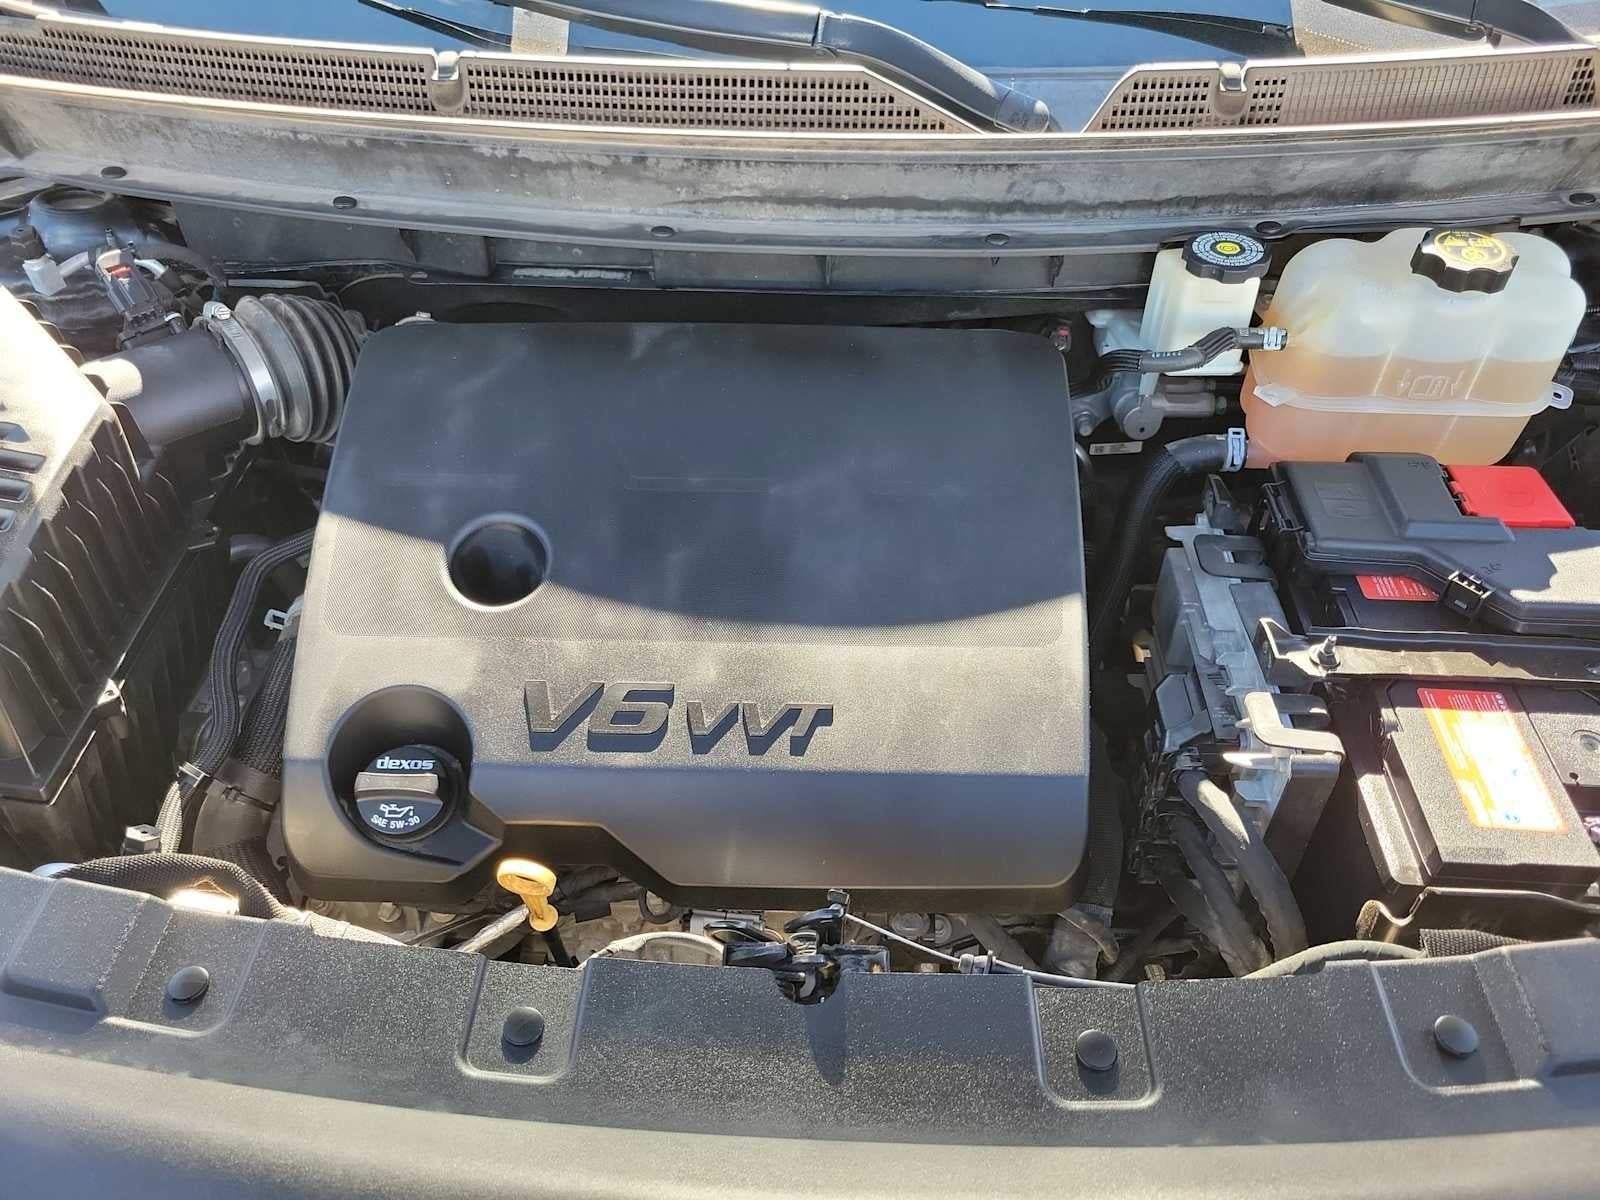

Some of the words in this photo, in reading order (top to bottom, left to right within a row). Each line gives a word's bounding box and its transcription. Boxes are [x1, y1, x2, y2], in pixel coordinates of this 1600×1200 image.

[524, 680, 674, 752] V6
[686, 701, 833, 756] VVT
[376, 756, 435, 770] dexos
[371, 814, 389, 828] SAE
[390, 815, 420, 829] 5W-30
